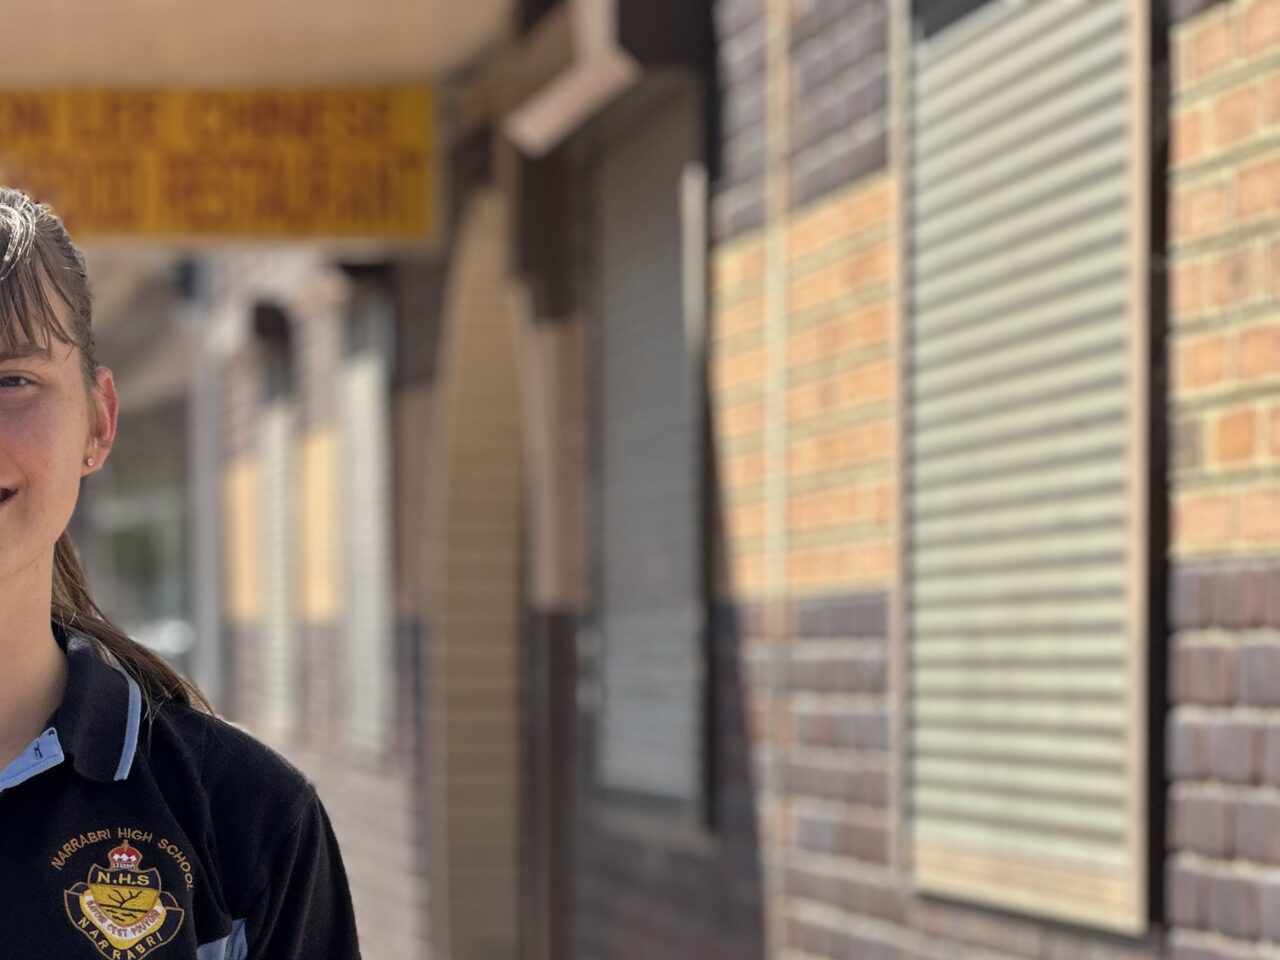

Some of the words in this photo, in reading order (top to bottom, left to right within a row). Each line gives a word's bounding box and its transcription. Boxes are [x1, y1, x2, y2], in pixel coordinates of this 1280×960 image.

[70, 89, 156, 140] LEE
[182, 88, 392, 140] CHINESE
[164, 150, 425, 231] RESTAURANT
[51, 829, 111, 870] NARRABRI
[117, 827, 153, 843] HIGH
[157, 838, 194, 892] SCHOOL
[78, 916, 163, 960] NARRABRI
